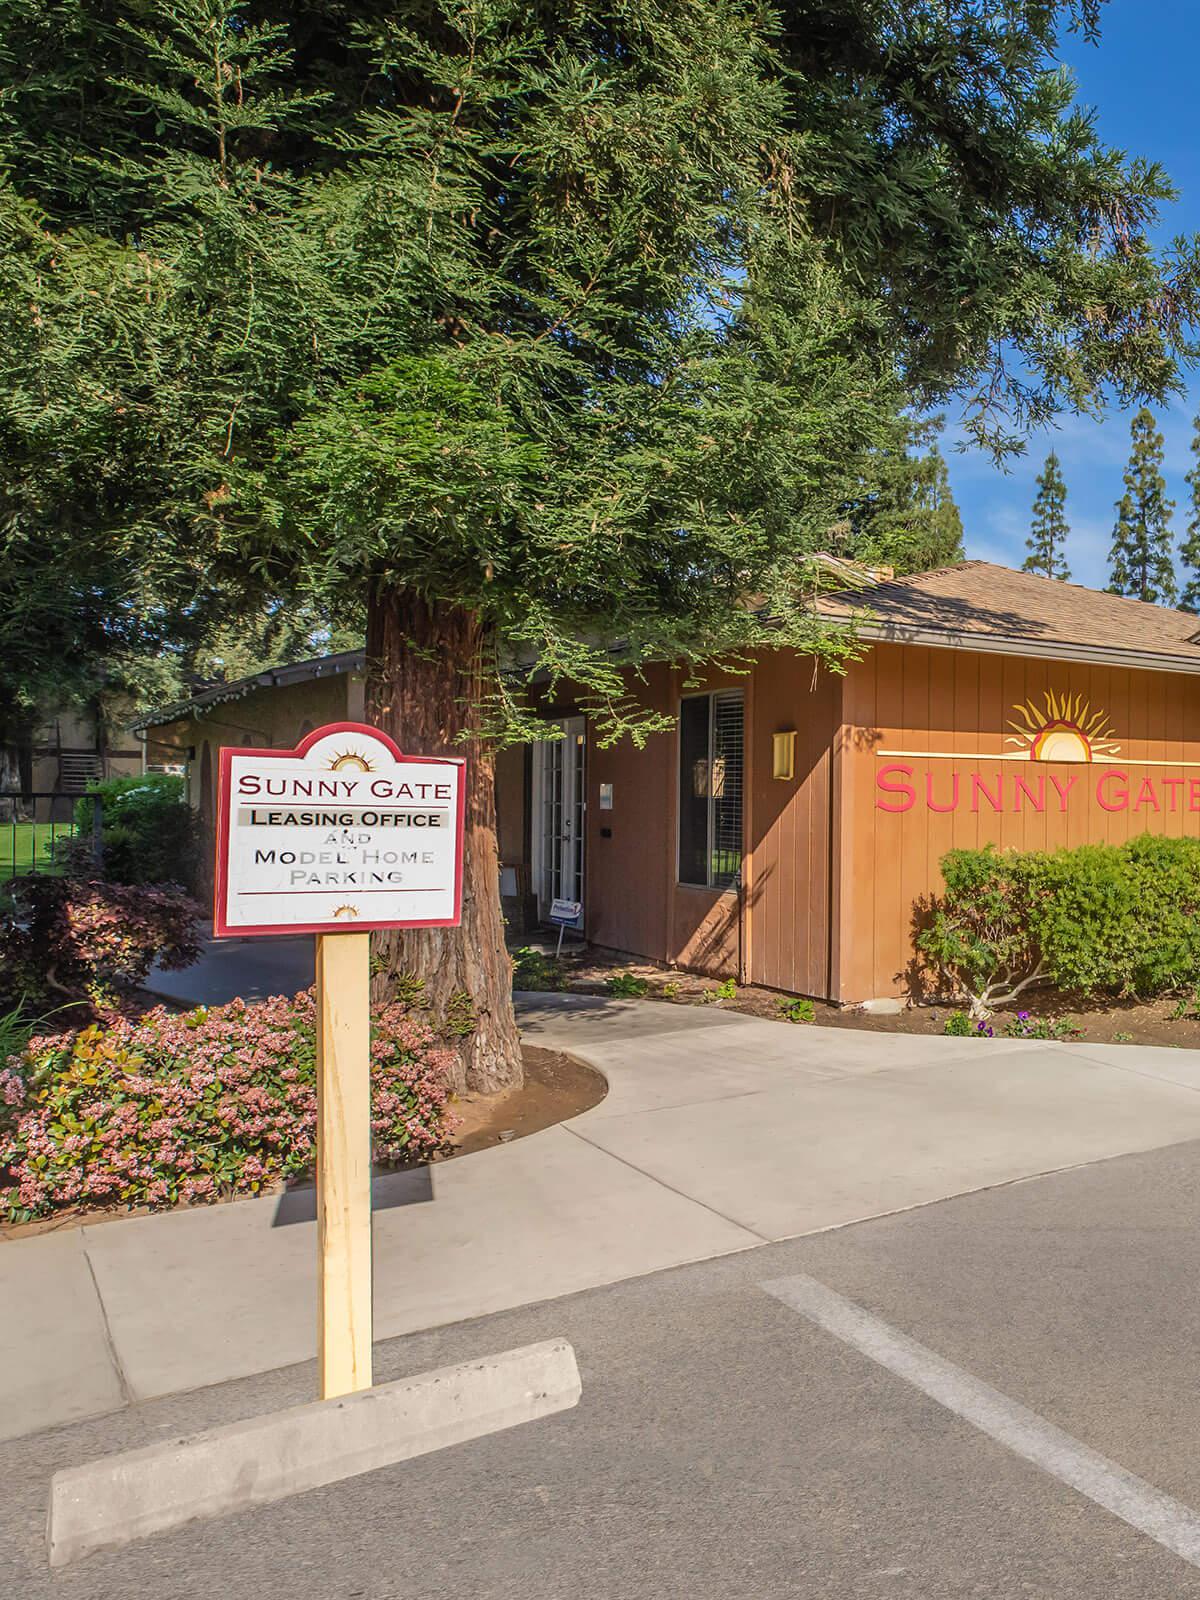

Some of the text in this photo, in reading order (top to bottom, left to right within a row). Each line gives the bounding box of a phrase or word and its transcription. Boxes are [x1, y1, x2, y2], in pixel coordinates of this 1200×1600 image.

[238, 775, 451, 800] SUNNY GATE
[875, 764, 1078, 813] SUNNY
[251, 810, 441, 827] LEASING OFFICE
[324, 833, 371, 845] AND
[255, 850, 434, 864] MODEL HOME
[290, 871, 403, 886] PARKING
